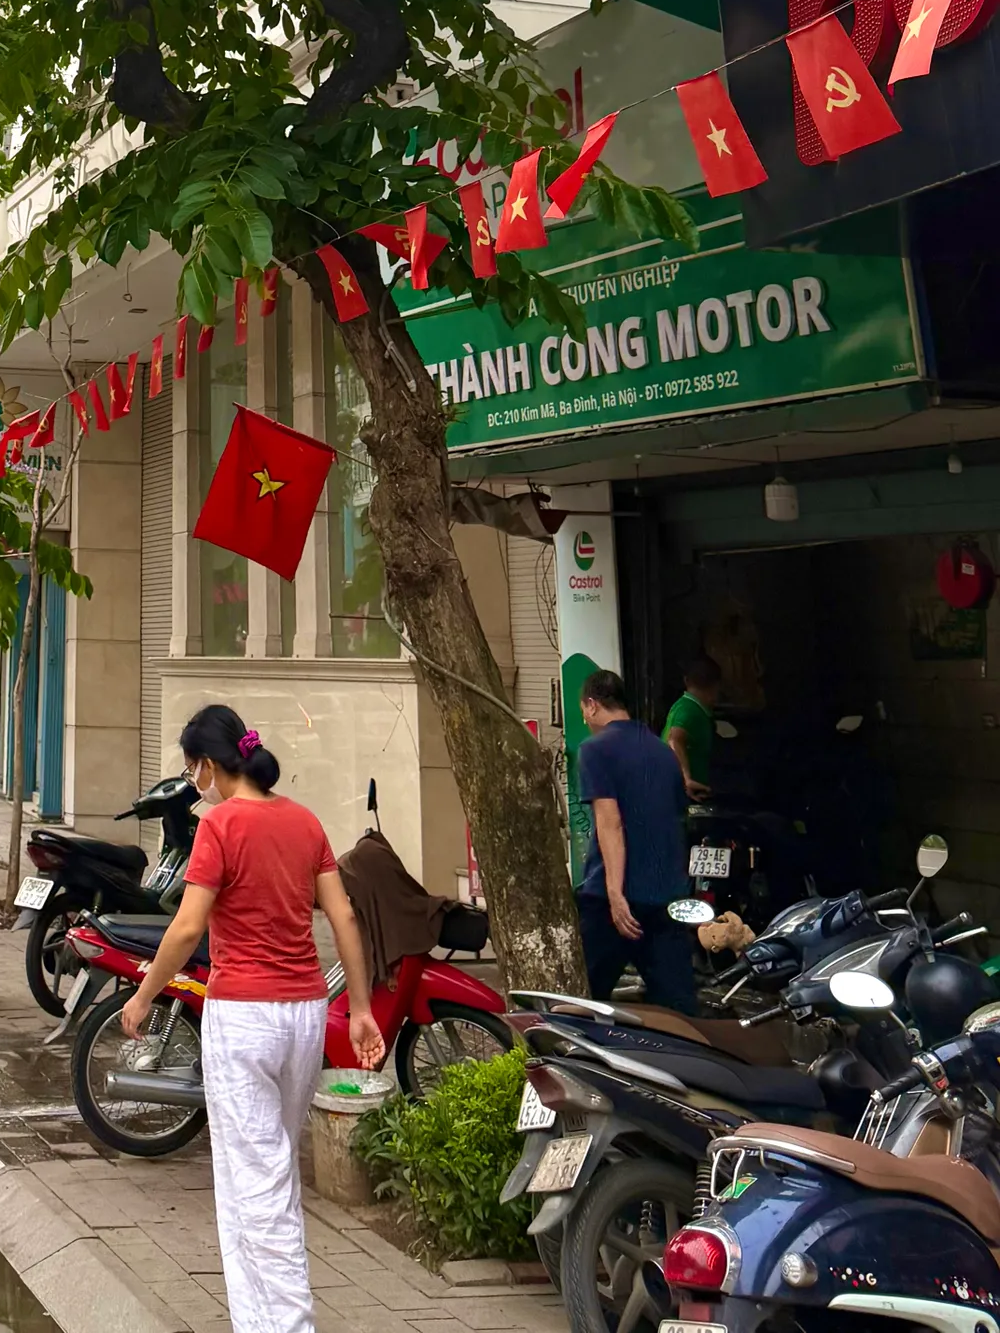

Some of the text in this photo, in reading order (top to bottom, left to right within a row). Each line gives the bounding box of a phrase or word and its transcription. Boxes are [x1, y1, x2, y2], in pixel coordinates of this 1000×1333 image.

[561, 255, 680, 306] HUYÊN NGHIỆP
[656, 276, 831, 363] MOTOR
[504, 408, 520, 425] 210
[521, 406, 539, 422] Kim
[541, 402, 558, 418] Mã,
[560, 401, 572, 415] Ba
[574, 395, 600, 412] Đình,
[602, 392, 617, 408] Hà
[618, 387, 638, 407] Nội
[645, 383, 663, 401] ĐT:
[665, 378, 692, 397] 0972
[694, 374, 714, 392] 585
[716, 370, 739, 388] 922
[568, 574, 603, 589] Castrol
[692, 861, 728, 876] 733.59
[697, 849, 726, 862] 29-AE
